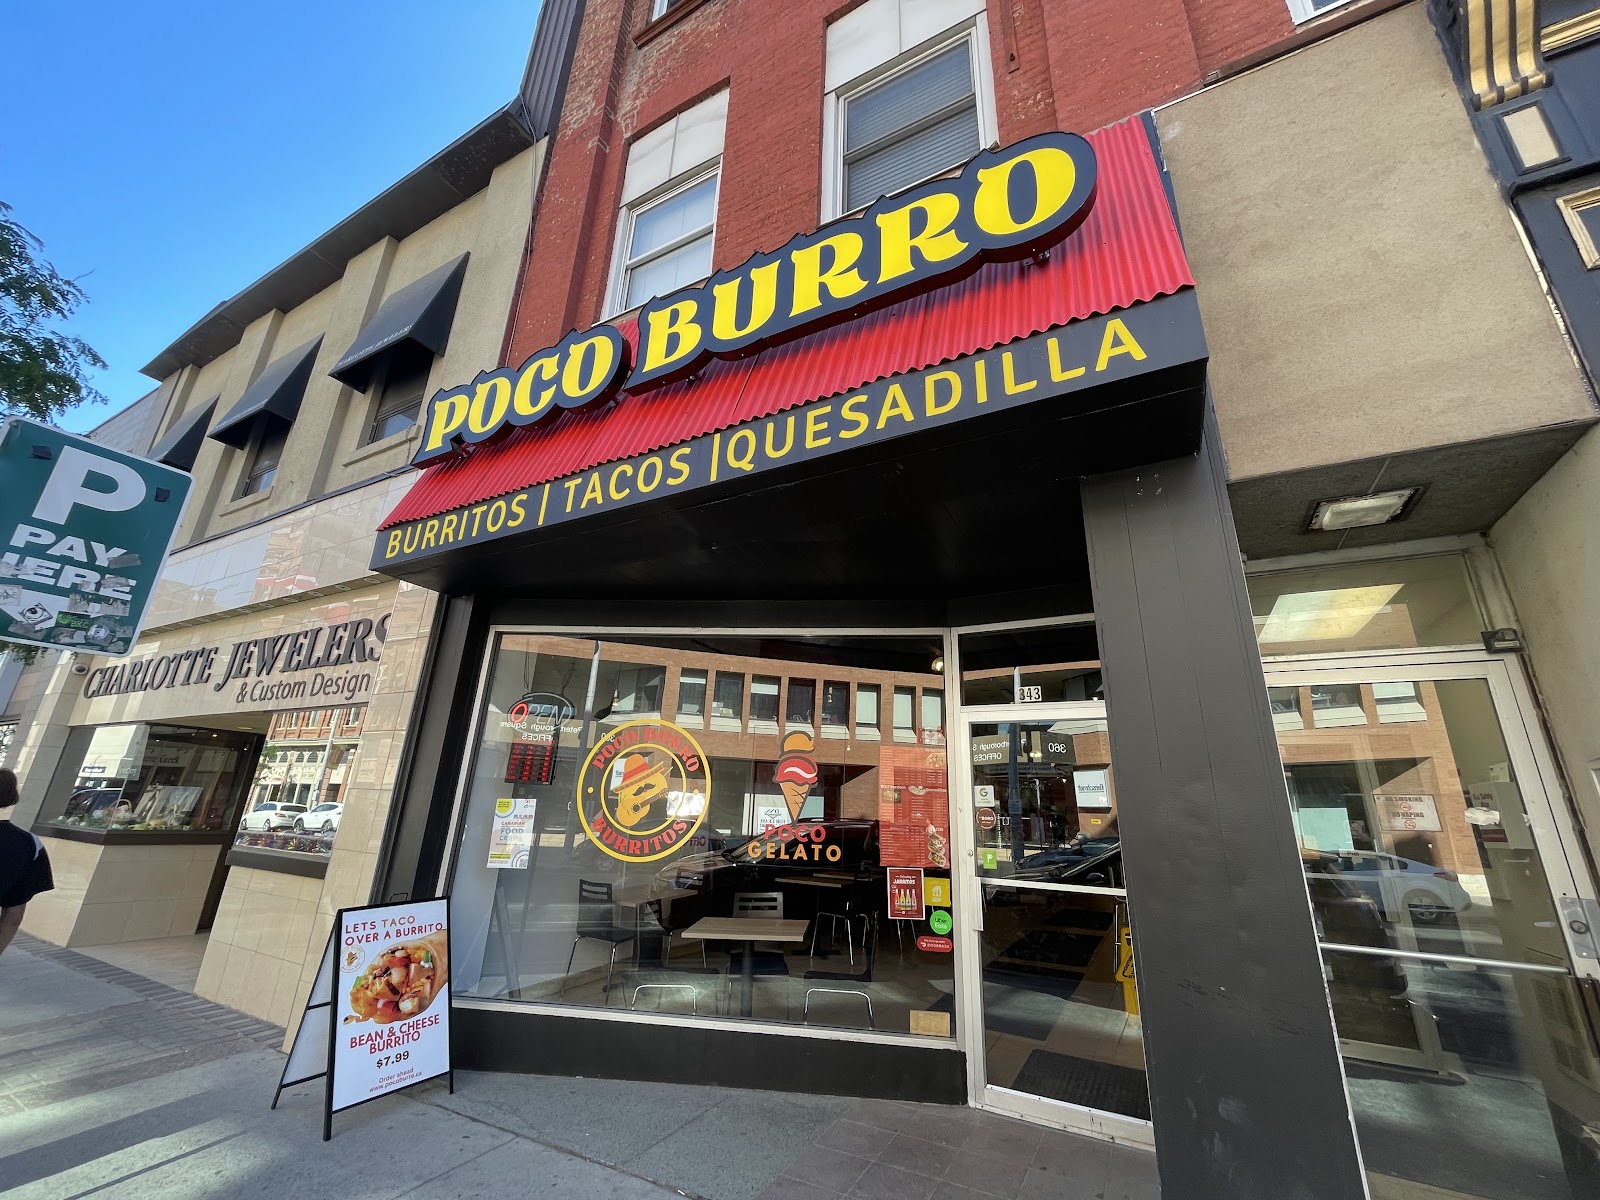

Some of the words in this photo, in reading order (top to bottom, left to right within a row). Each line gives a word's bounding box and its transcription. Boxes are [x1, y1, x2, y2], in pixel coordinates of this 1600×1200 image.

[425, 334, 615, 453] POCO
[640, 146, 1077, 375] BURRO
[32, 445, 147, 525] P
[385, 493, 527, 559] BURRITOS
[564, 446, 691, 515] TACOS
[9, 523, 128, 567] PAY
[84, 646, 219, 699] CHARLOTTE
[214, 612, 391, 691] JEWELERS
[236, 682, 249, 703] &
[249, 679, 307, 702] Custom
[309, 670, 371, 702] Design
[1018, 687, 1041, 701] 343
[511, 703, 567, 725] OPEN
[592, 730, 638, 770] POCO
[644, 727, 700, 772] BURRO
[591, 817, 688, 855] BURRITOS
[764, 824, 826, 843] POCO
[747, 841, 842, 862] GELATO
[345, 920, 377, 934] LETS
[382, 915, 416, 928] TACO
[345, 932, 379, 946] OVER
[384, 930, 391, 939] A
[395, 922, 443, 938] BURRITO
[350, 1030, 384, 1049] BEAN
[387, 1026, 396, 1037] &
[399, 1014, 440, 1034] CHEESE
[369, 1030, 421, 1054] BURRITO
[376, 1050, 410, 1069] $7.99
[378, 1074, 396, 1083] Order
[396, 1067, 414, 1078] ahead
